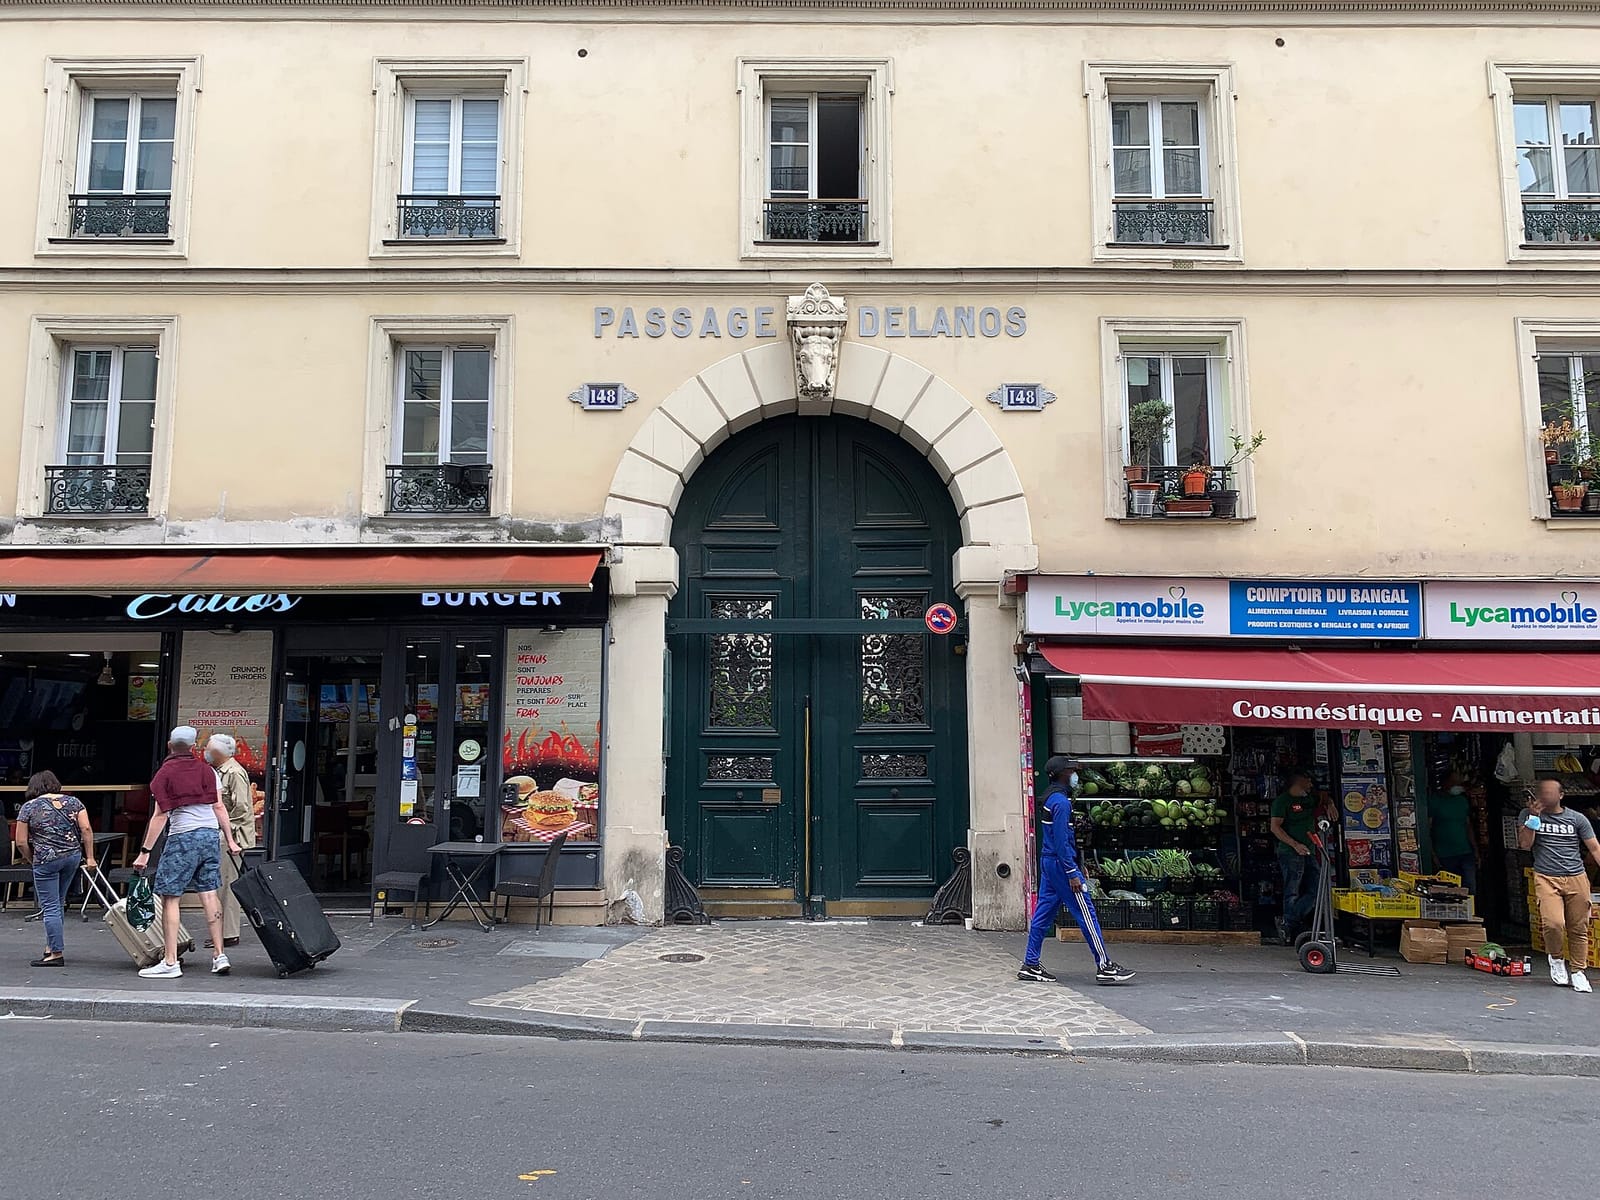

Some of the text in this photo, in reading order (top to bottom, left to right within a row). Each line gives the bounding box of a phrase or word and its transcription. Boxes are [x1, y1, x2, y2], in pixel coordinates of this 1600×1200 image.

[594, 306, 1027, 338] PASSAGE DELANOS
[590, 389, 616, 404] 148
[1009, 390, 1035, 404] 148
[421, 592, 562, 606] BURGER
[1246, 587, 1409, 604] COMPTOIR DU BANGAL
[1055, 596, 1204, 620] Lycamobile
[1294, 607, 1328, 615] GÉNÉRALE
[1372, 608, 1378, 616] À
[1450, 602, 1598, 627] Lycamobile
[517, 654, 547, 664] MENUS
[516, 675, 564, 685] TOUJOURS
[516, 708, 540, 718] FRAIS
[1232, 700, 1423, 725] Cosméstique
